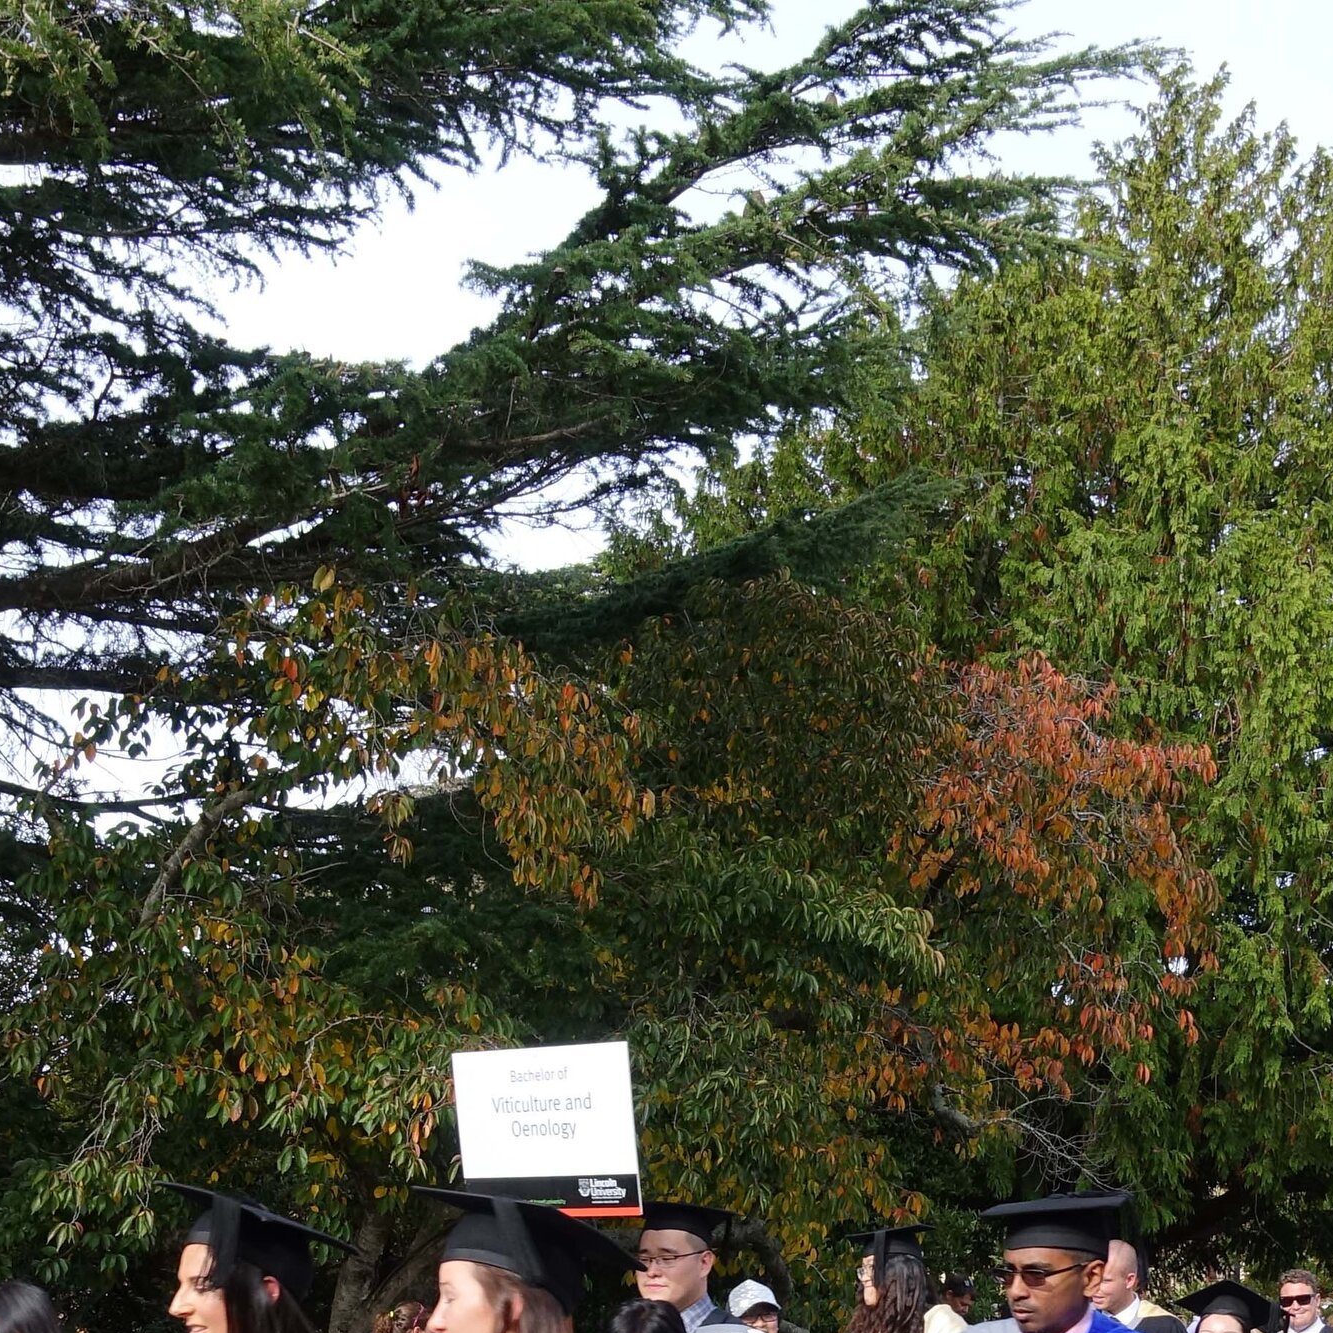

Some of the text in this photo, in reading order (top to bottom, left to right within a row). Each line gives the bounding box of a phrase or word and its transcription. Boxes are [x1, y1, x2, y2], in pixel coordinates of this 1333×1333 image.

[509, 1066, 568, 1083] Bachelor of
[491, 1091, 592, 1114] Viticulture and
[511, 1118, 576, 1140] Oenology
[589, 1178, 617, 1187] Lincoln
[590, 1187, 626, 1198] University
